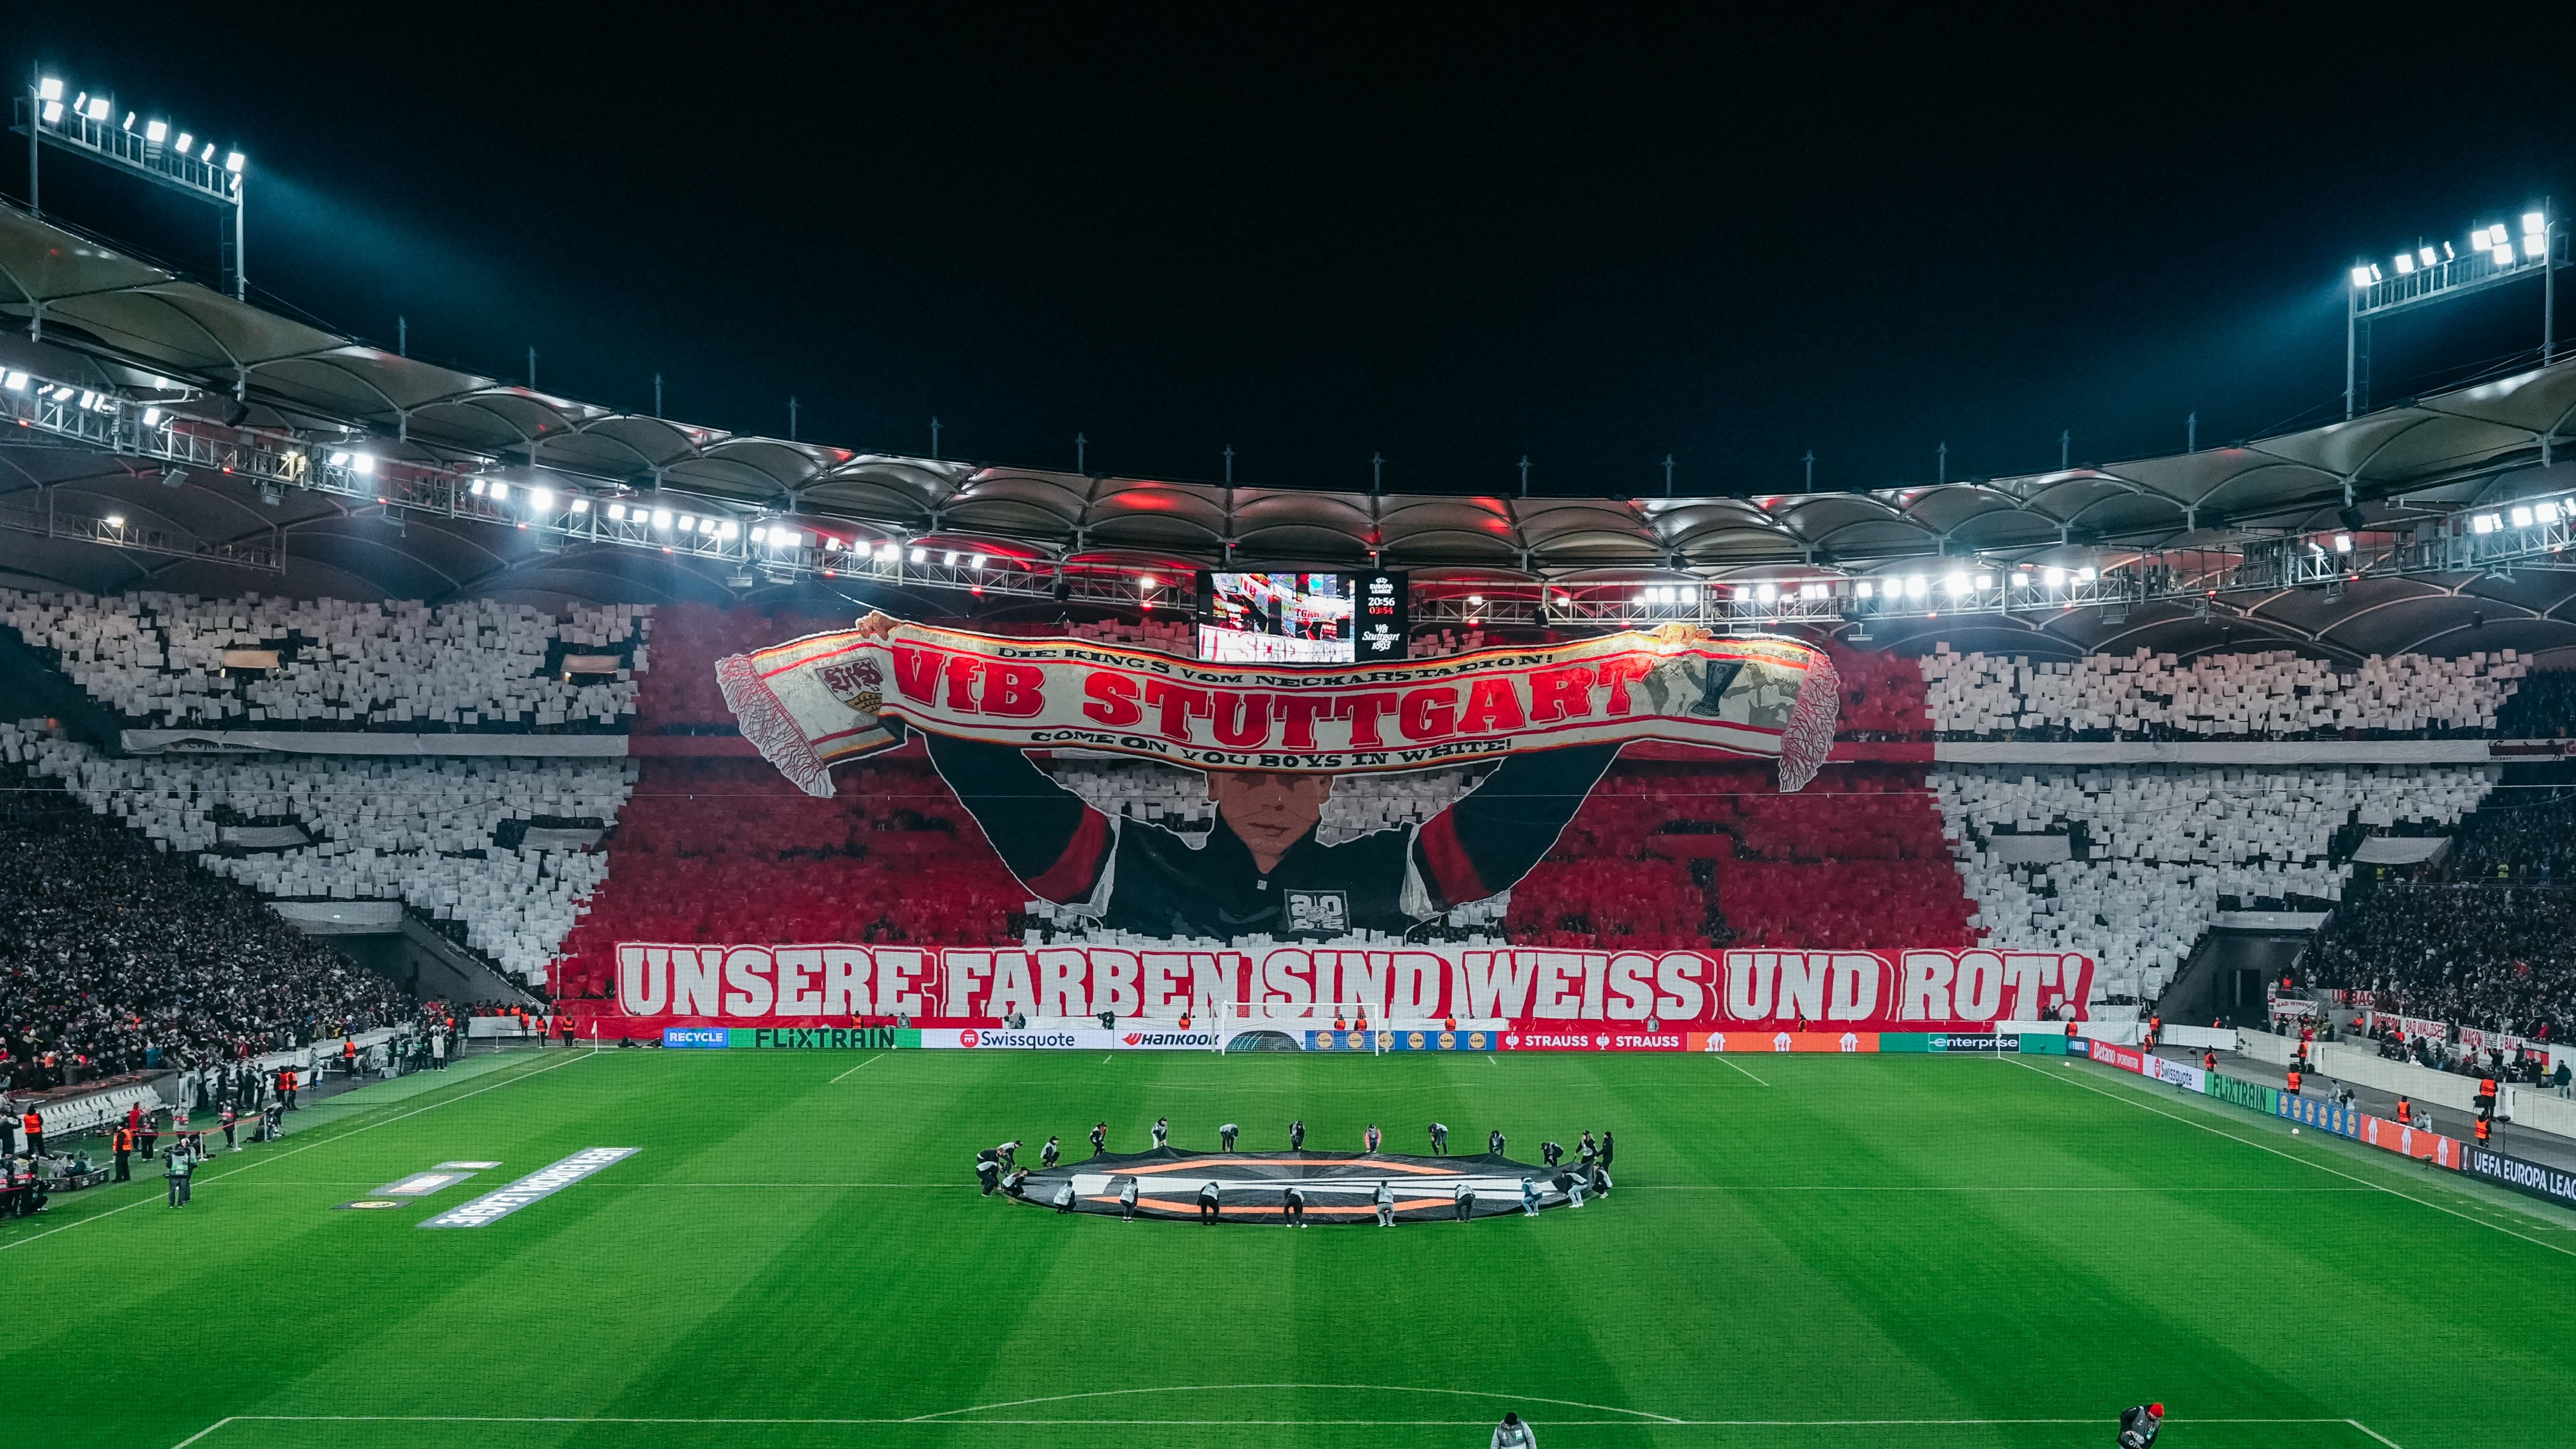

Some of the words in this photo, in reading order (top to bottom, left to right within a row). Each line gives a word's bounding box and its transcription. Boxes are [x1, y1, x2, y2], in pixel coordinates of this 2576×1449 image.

[1368, 597, 1395, 606] 20:56
[1362, 631, 1400, 643] Stuttgart
[1375, 624, 1388, 634] VfB
[1371, 640, 1391, 651] 1893
[999, 647, 1057, 658] DIE
[1064, 649, 1170, 673] KINGS
[1180, 668, 1243, 683] VOM
[1255, 654, 1553, 686] NECKARSTADION!
[892, 646, 1046, 718] VfB
[1083, 655, 1655, 750] STUTTGART
[1031, 730, 1116, 743] COME
[1120, 737, 1168, 753] ON
[1183, 748, 1250, 765] YOU
[1258, 754, 1342, 767] BOYS
[1352, 752, 1388, 765] IN
[1398, 738, 1512, 763] WHITE!
[621, 947, 922, 1017] UNSERE
[945, 951, 1241, 1018] FARBEN
[1265, 950, 1439, 1019] SIND
[1464, 951, 1704, 1020] WEISS
[1728, 954, 1880, 1021] UND
[1902, 953, 2082, 1021] ROT!
[669, 1032, 723, 1043] RECYCLE
[755, 1029, 895, 1048] FLiXTRAIN
[982, 1031, 1075, 1049] Swissquote
[1525, 1035, 1588, 1047] STRAUSS
[1616, 1035, 1679, 1047] STRAUSS
[1931, 1037, 2019, 1050] enterprise
[2093, 1041, 2116, 1064] Betano
[2161, 1061, 2192, 1086] Swissquote
[565, 1148, 633, 1164] UEFA
[503, 1164, 598, 1192] EUROPA
[2474, 1151, 2502, 1178] UEFA
[2504, 1159, 2547, 1191] EUROPA
[434, 1193, 540, 1225] LEAGUE
